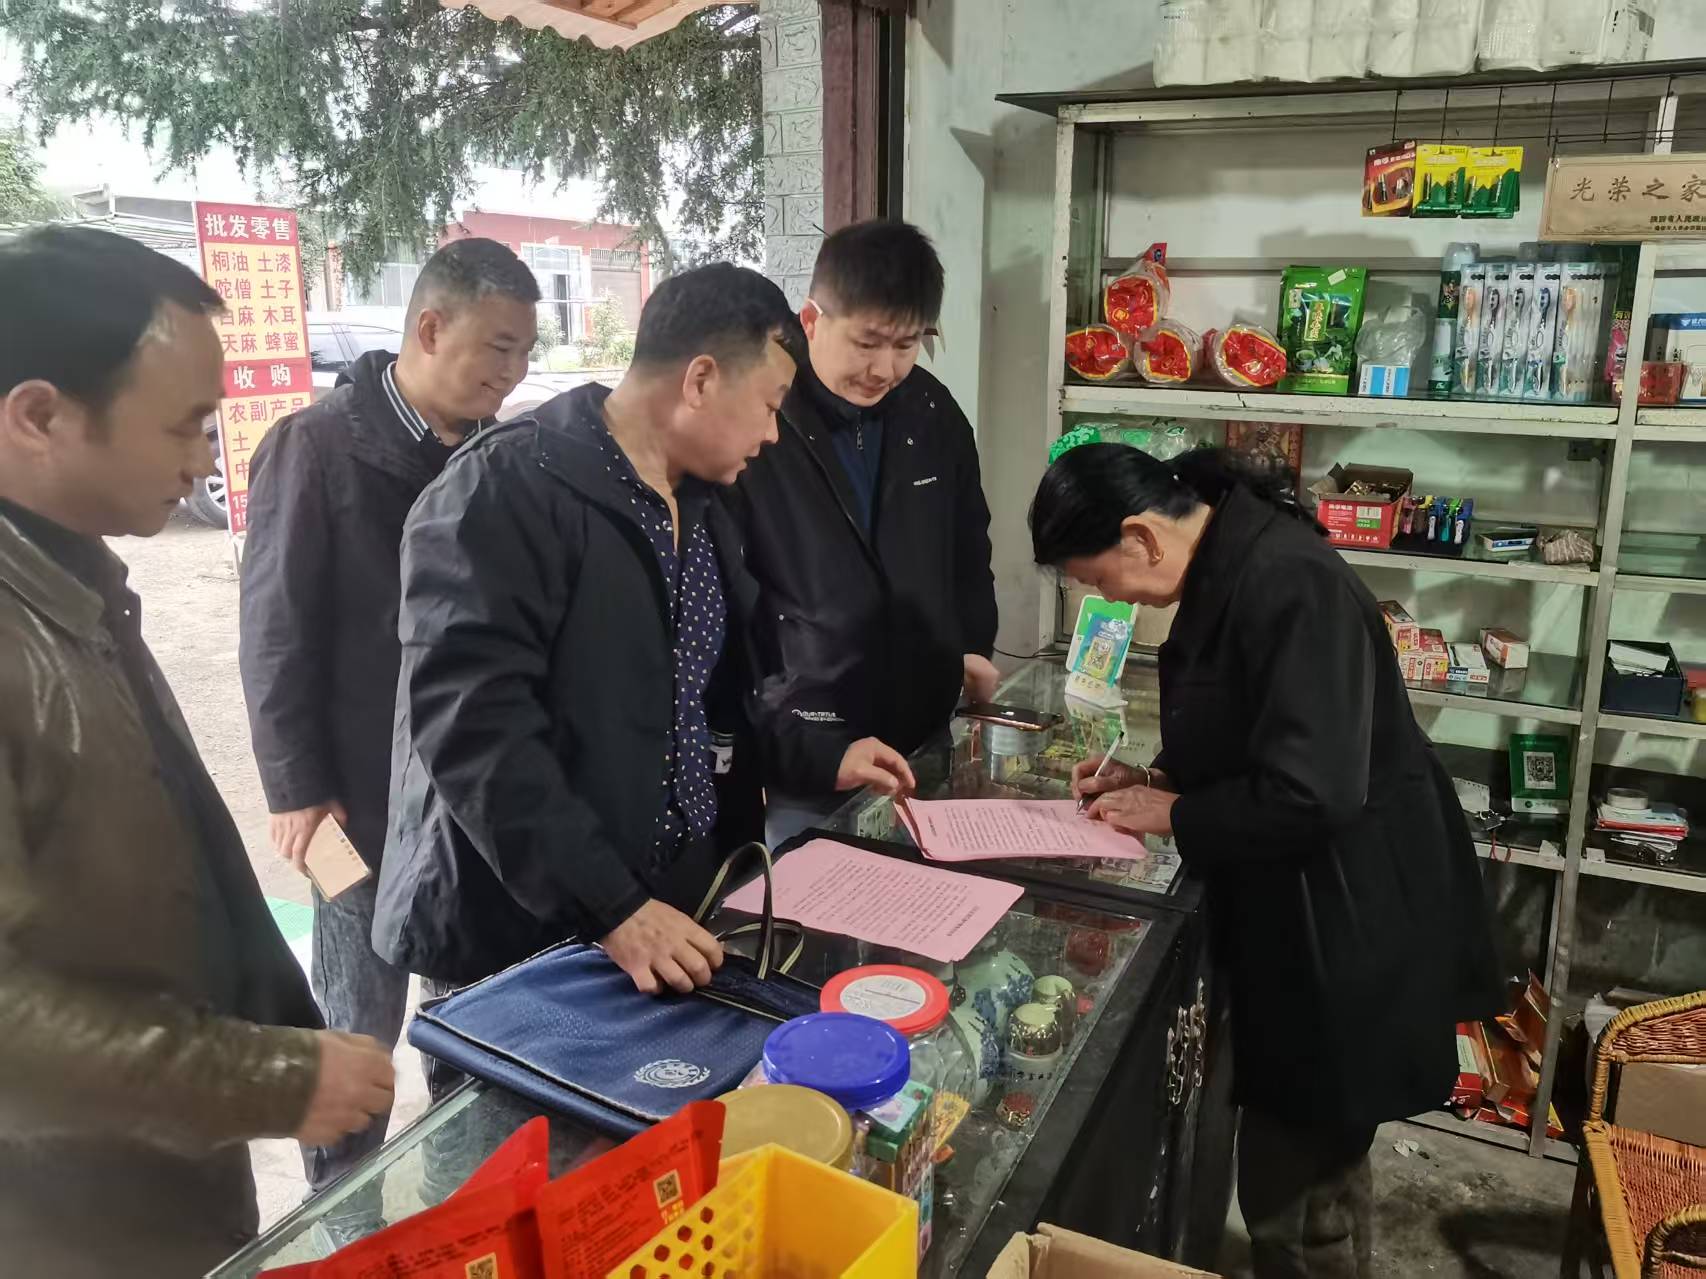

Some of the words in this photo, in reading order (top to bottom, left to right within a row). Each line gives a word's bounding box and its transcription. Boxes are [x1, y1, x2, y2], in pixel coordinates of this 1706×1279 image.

[1569, 173, 1706, 203] 光荣之家
[204, 212, 291, 241] 批发零售
[211, 248, 249, 273] 桐油
[257, 250, 292, 274] 土漆
[260, 278, 295, 300] 土子
[262, 304, 297, 326] 木耳
[220, 332, 258, 353] 天麻
[264, 330, 300, 352] 蜂蜜
[233, 363, 292, 389] 收购
[228, 397, 304, 425] 农副产品
